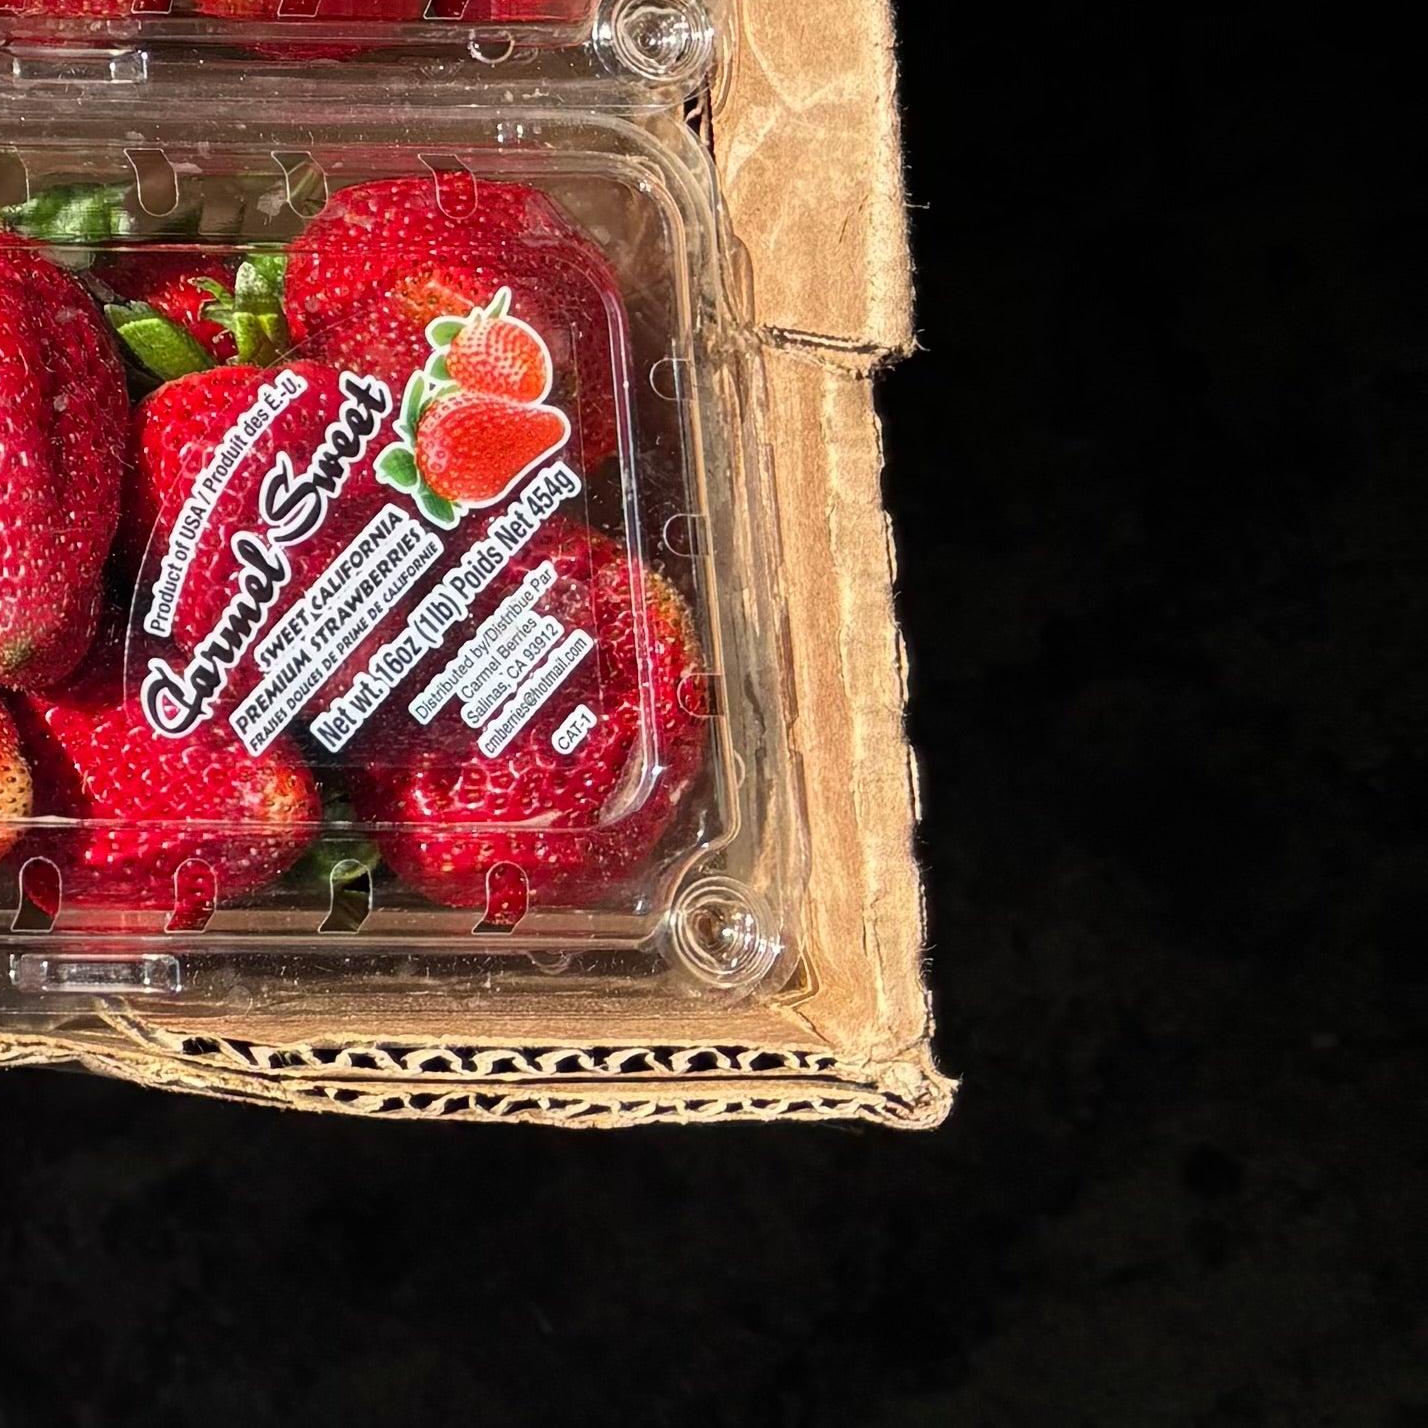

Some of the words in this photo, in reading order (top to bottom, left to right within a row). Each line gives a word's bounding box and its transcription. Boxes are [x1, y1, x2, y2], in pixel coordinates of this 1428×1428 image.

[201, 433, 249, 494] Produit
[243, 408, 270, 438] des
[147, 537, 287, 732] Carmel
[265, 377, 386, 541] Sweet
[174, 539, 191, 562] of
[180, 505, 208, 541] USA
[149, 562, 182, 633] Product
[234, 648, 313, 736] PREMIUM
[309, 526, 421, 653] STRAWBERRIES
[259, 607, 310, 668] SWEET
[310, 511, 404, 611] CALIFORNIA
[316, 705, 358, 748] Net
[348, 680, 384, 714] wt.
[374, 635, 423, 683] 16oz
[412, 591, 463, 645] (1lb)
[448, 545, 505, 601] Poids
[493, 509, 535, 552] Net
[525, 468, 577, 517] 454g
[414, 653, 476, 720] Distributed
[529, 568, 553, 593] Par
[460, 654, 502, 700] Carmel
[495, 617, 538, 660] Berries
[466, 681, 512, 725] Salinas,
[505, 658, 528, 680] CA
[522, 622, 559, 662] 93912
[484, 636, 588, 755] cmberries@hotmail.com
[557, 712, 592, 751] CAT-1
